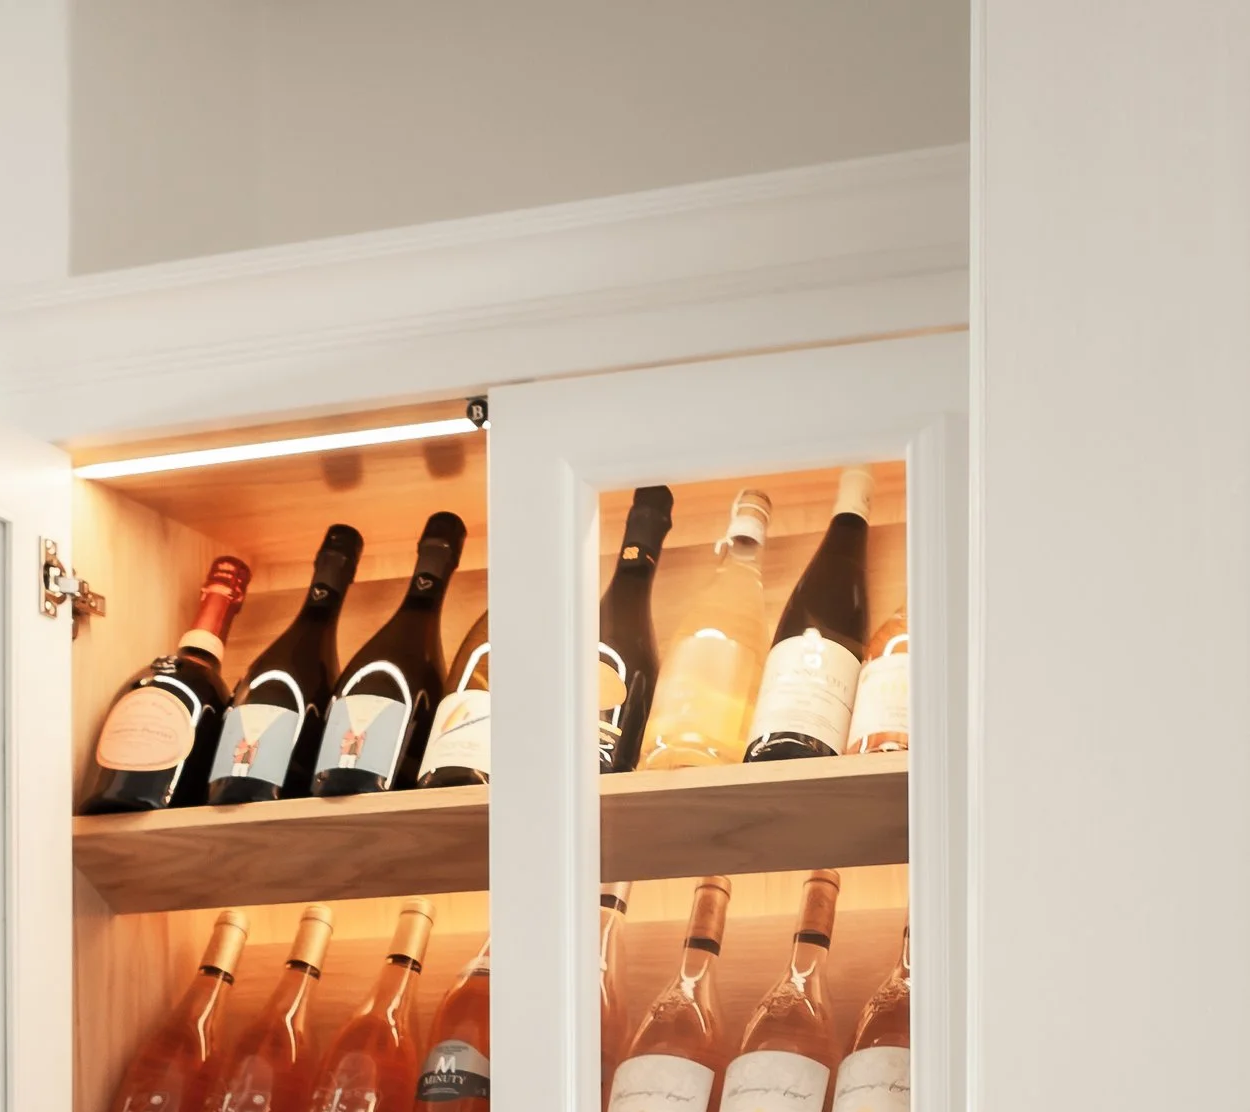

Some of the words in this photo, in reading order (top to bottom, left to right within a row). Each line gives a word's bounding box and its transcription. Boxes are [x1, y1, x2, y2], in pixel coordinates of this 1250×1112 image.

[471, 405, 484, 420] B
[435, 1055, 456, 1074] M
[423, 1074, 467, 1088] MINUTY
